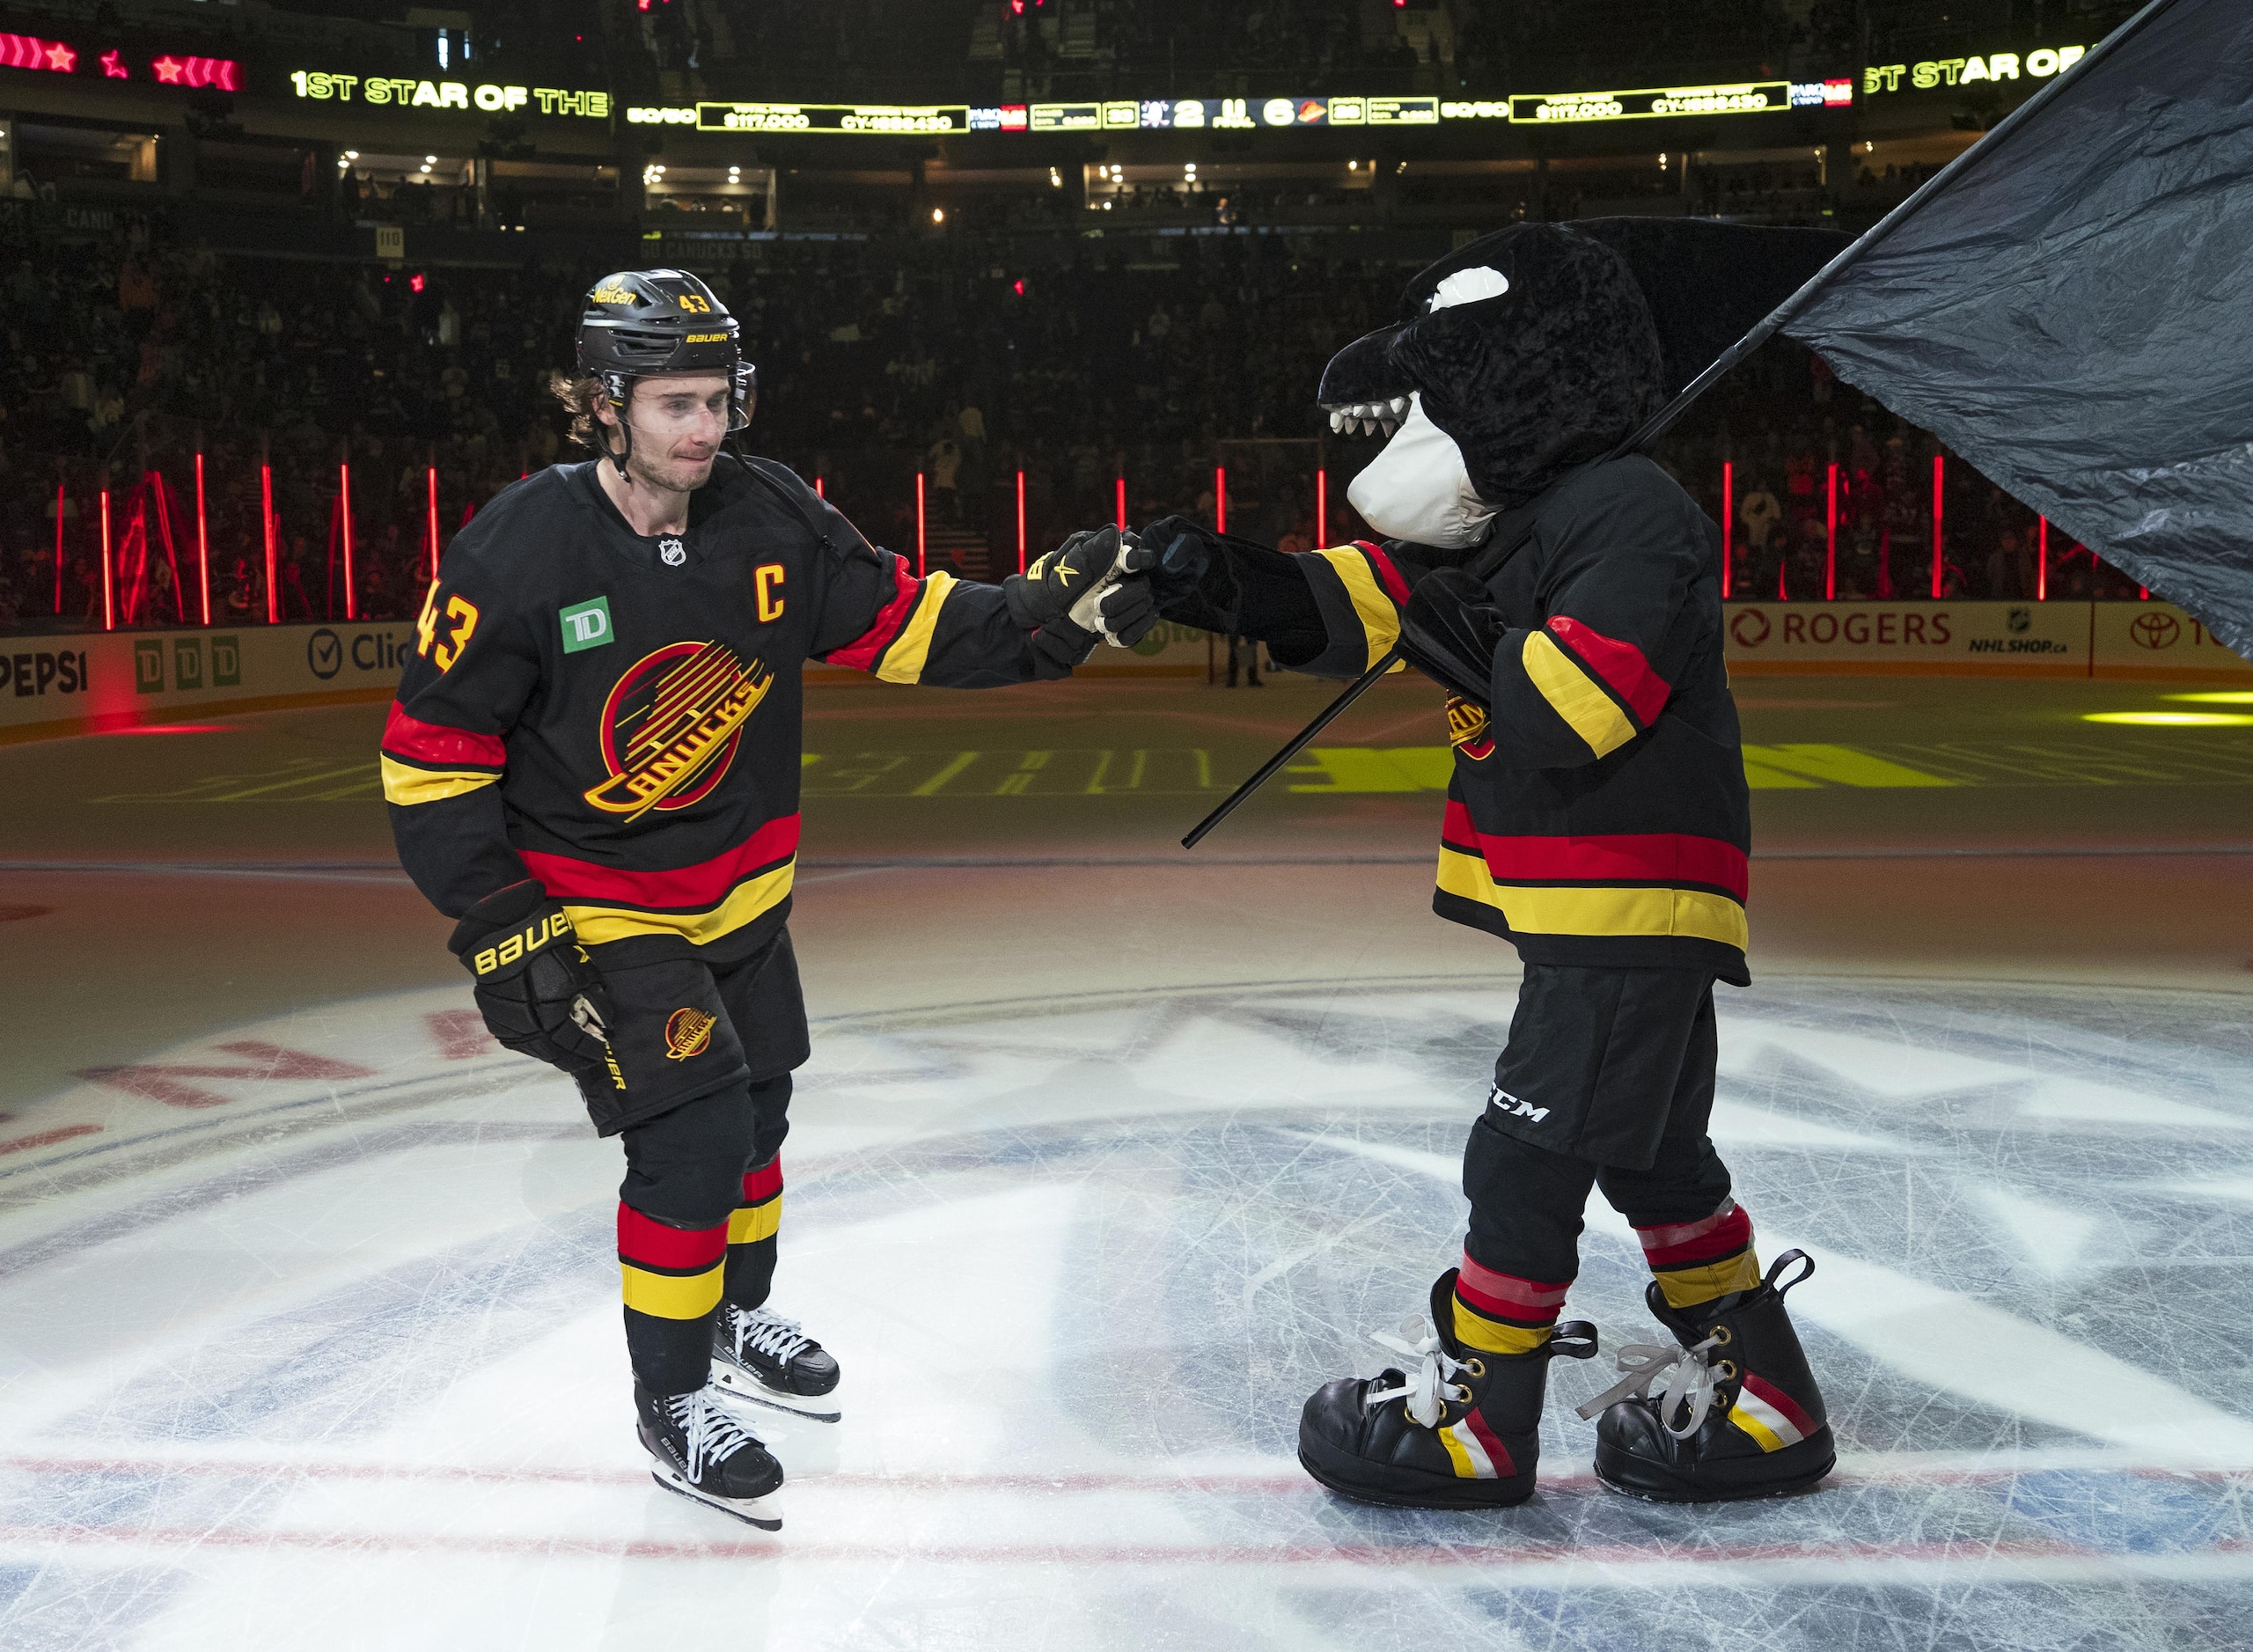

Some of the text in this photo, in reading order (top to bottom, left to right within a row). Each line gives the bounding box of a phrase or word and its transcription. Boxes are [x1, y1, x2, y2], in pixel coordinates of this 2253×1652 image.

[1863, 64, 1906, 94] ST
[1912, 53, 2020, 88] STAR
[2026, 45, 2085, 77] OF
[291, 70, 609, 118] 1ST STAR OF THE
[627, 107, 697, 124] 50/50
[724, 114, 809, 129] $117,000
[1174, 99, 1205, 128] 2
[1264, 99, 1295, 126] 6
[1442, 102, 1510, 118] 50/50
[1537, 102, 1623, 121] $117,000
[592, 287, 636, 305] NexGen
[679, 295, 710, 313] 43
[686, 334, 728, 343] BAUER
[754, 562, 785, 624] C
[417, 577, 481, 676] 43
[565, 608, 606, 642] TD
[1784, 613, 1950, 645] ROGERS
